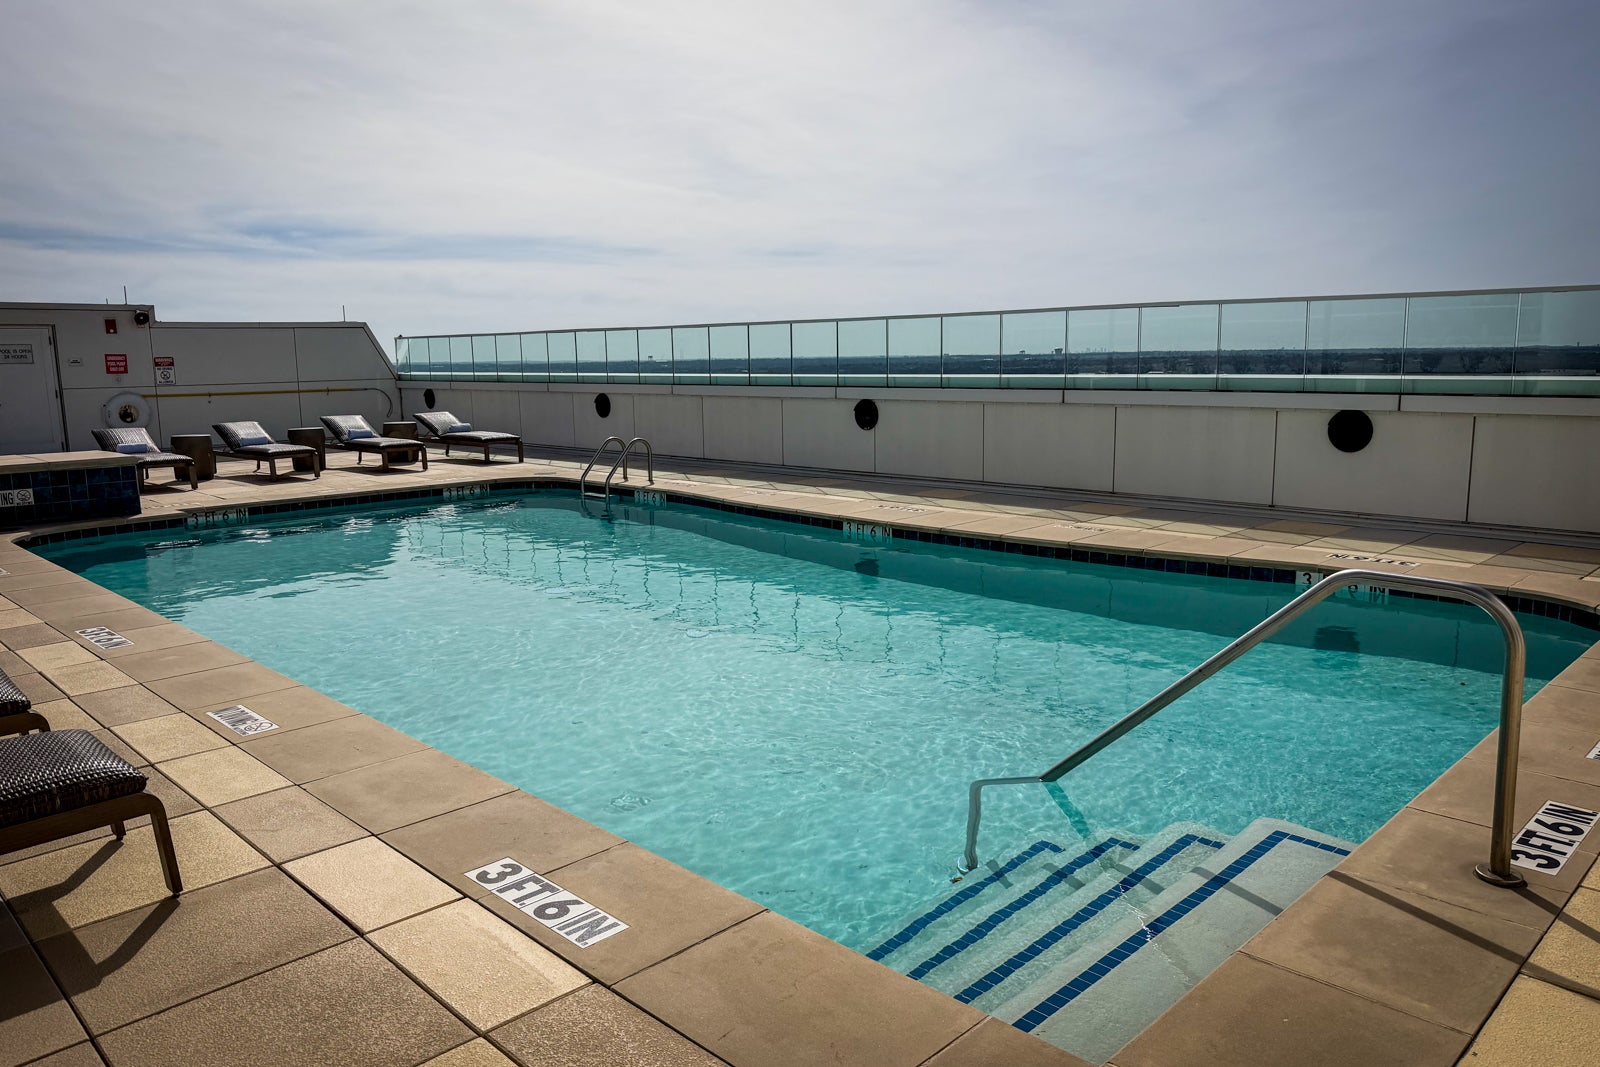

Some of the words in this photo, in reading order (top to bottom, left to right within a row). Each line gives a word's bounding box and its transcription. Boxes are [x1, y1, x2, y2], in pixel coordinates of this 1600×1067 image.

[0, 492, 14, 505] ING
[1534, 818, 1585, 837] 6
[1510, 849, 1561, 870] 3
[475, 863, 523, 885] 3
[533, 899, 585, 921] 6
